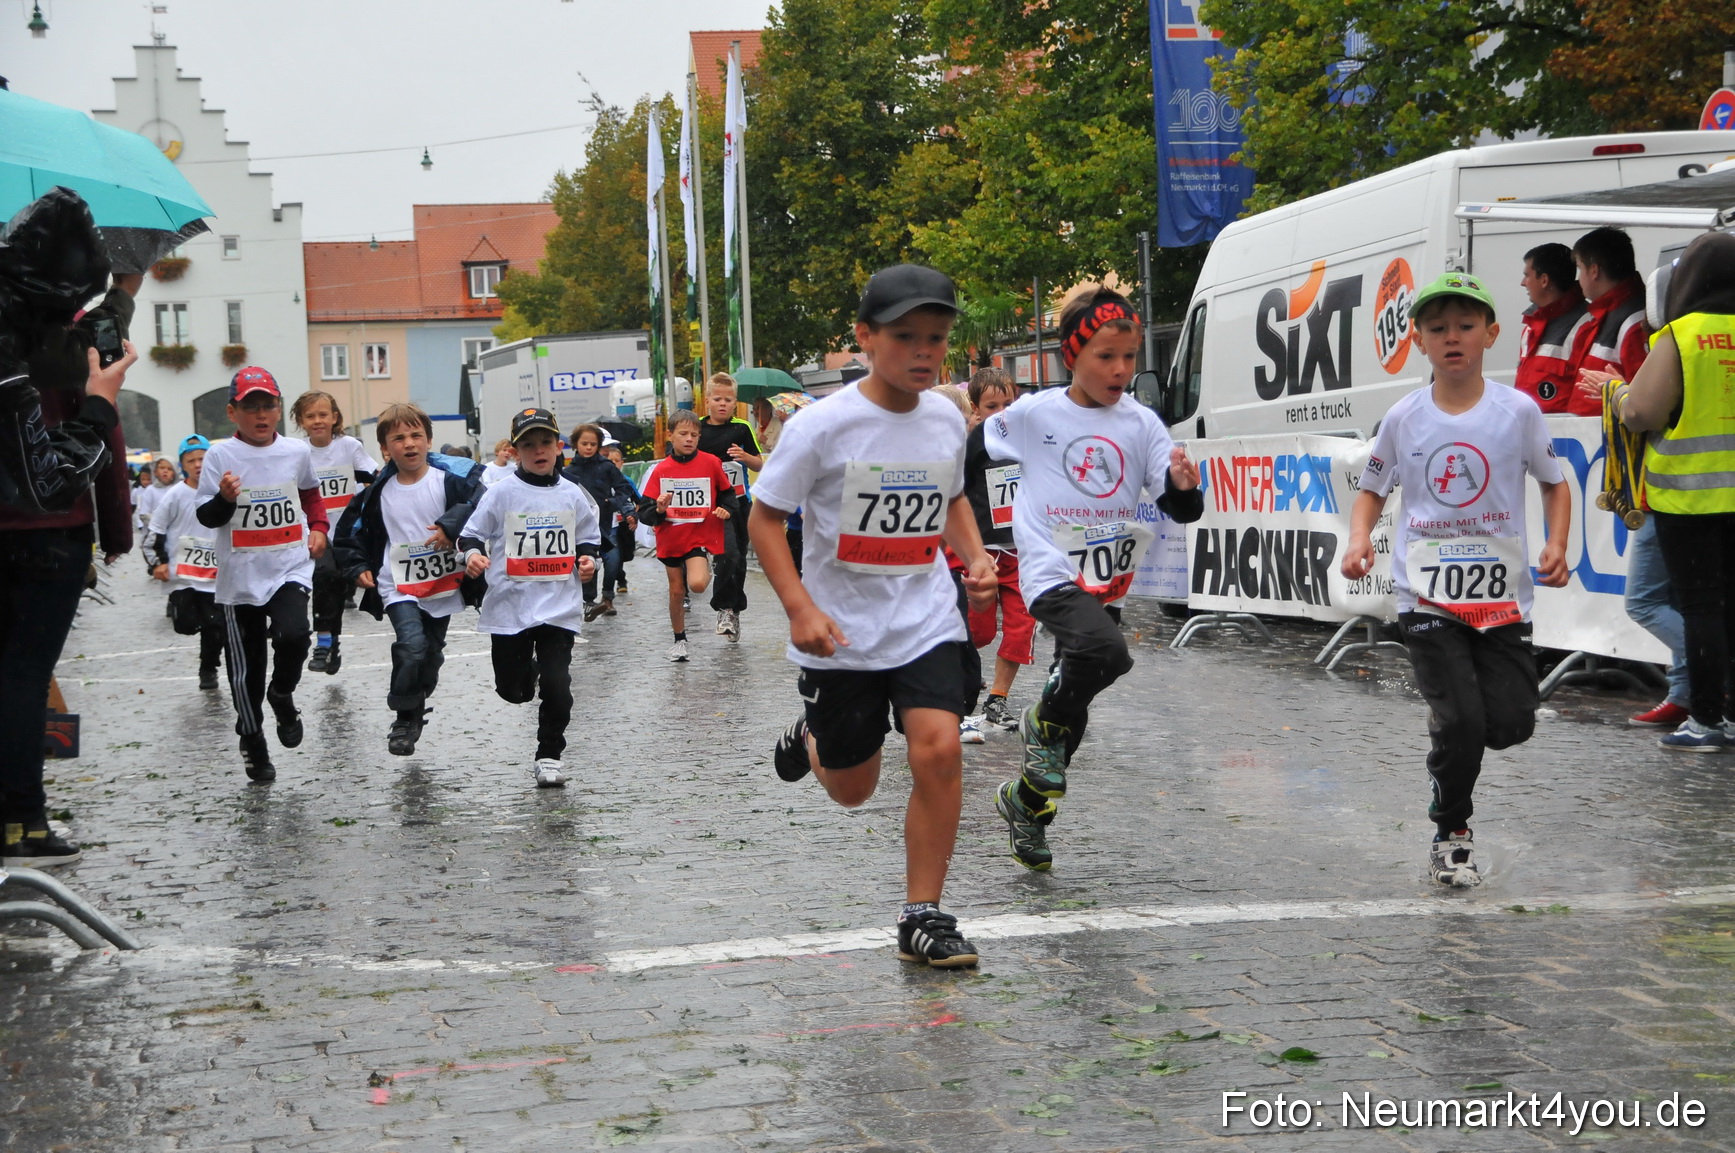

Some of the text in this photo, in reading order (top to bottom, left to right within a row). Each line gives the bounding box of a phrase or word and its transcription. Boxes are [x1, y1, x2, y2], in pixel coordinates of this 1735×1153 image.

[1168, 88, 1241, 134] 100
[550, 368, 638, 391] BOCK
[1286, 397, 1352, 423] rent a truck
[320, 477, 349, 497] 197
[881, 470, 928, 484] BOCK
[250, 488, 282, 499] BOCK
[666, 490, 705, 507] 7103
[237, 500, 296, 529] 7306
[526, 516, 558, 526] BOCK
[857, 492, 944, 535] 7322
[1095, 509, 1114, 518] MIT
[1456, 517, 1478, 527] MIT
[1482, 511, 1511, 524] HERZ
[1084, 523, 1126, 540] BOCK
[513, 529, 569, 557] 7120
[842, 540, 916, 563] Andreas
[1438, 544, 1488, 555] BOCK
[398, 550, 457, 582] 7335
[527, 561, 561, 573] Simon
[1192, 526, 1338, 608] HACKNER
[1347, 574, 1372, 595] 2318
[1420, 563, 1508, 601] 7028
[1431, 619, 1443, 629] M.
[903, 902, 933, 912] PORT
